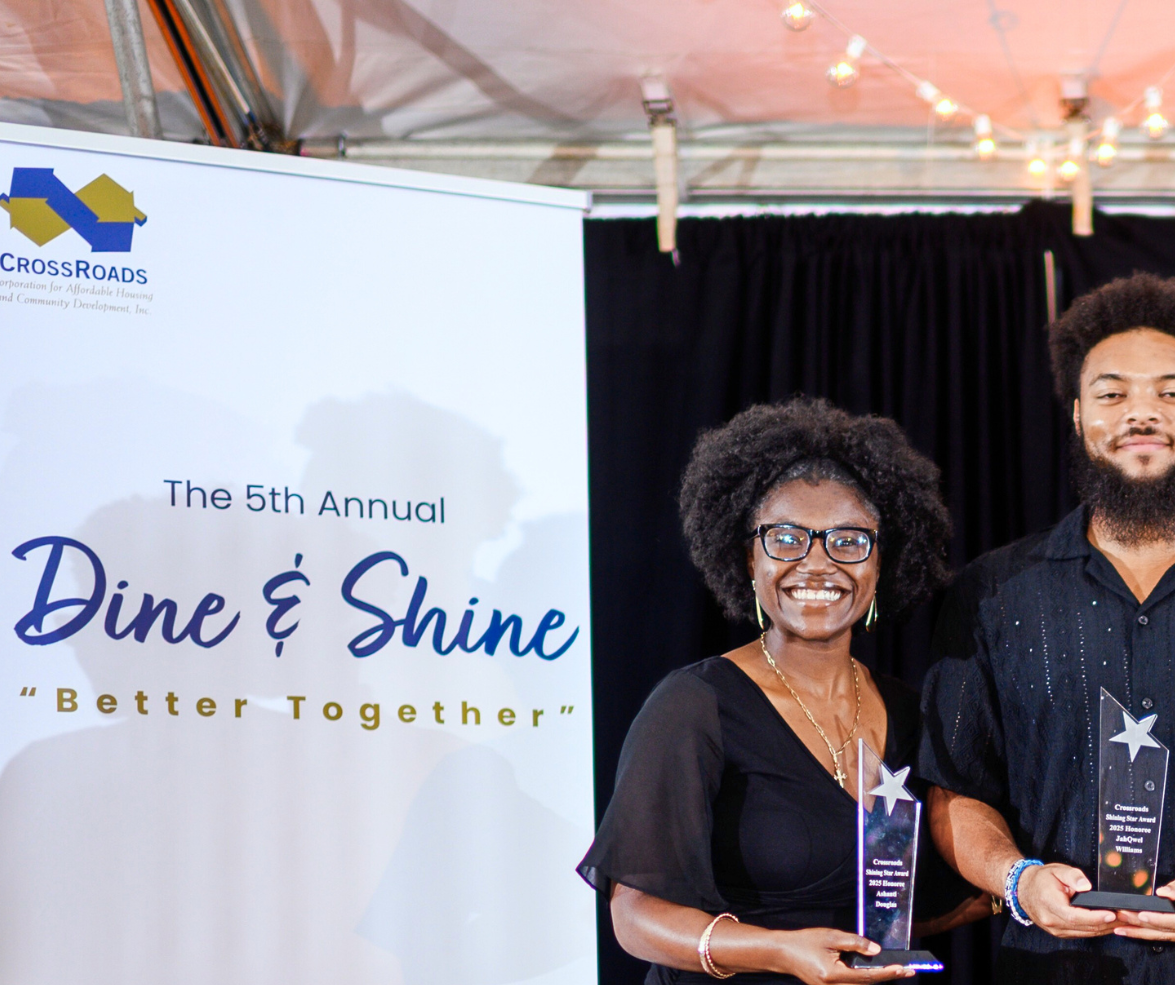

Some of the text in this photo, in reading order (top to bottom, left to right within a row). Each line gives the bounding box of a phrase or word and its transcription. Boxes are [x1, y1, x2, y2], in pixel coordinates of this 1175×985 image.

[0, 280, 154, 303] orporation for Affordable Housing
[16, 293, 70, 310] Community
[73, 298, 132, 315] Development,
[135, 304, 152, 315] Inc.
[163, 479, 445, 524] The 5th Annual
[10, 534, 580, 661] Dine & Shine
[1106, 814, 1126, 822] Shining
[1115, 804, 1149, 812] Crossroads
